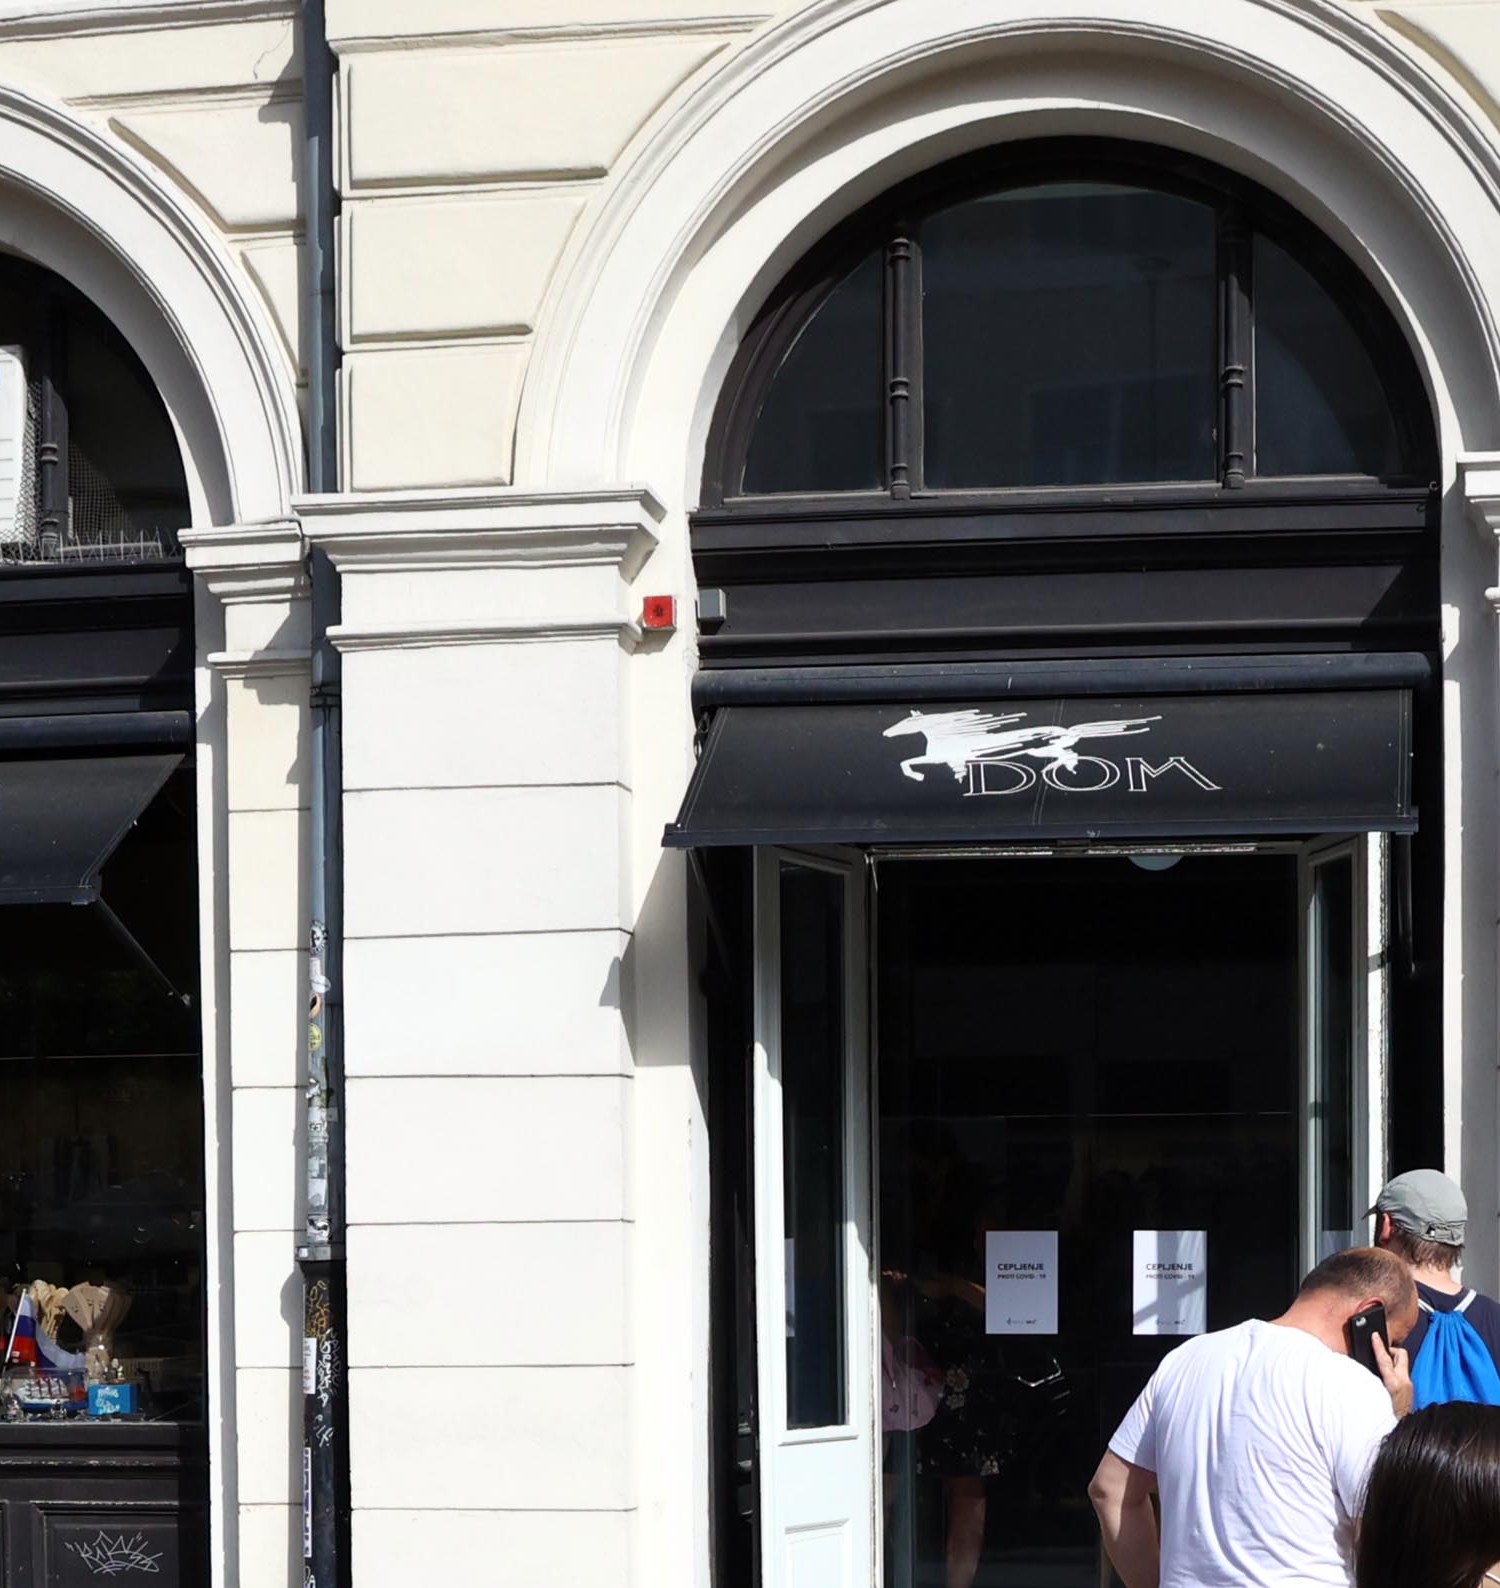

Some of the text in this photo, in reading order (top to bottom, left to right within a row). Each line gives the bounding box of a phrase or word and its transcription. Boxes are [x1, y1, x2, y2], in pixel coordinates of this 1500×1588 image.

[963, 755, 1223, 797] DOM
[997, 1263, 1044, 1271] CEPLJENJE
[1145, 1263, 1193, 1271] CEPLJENJE
